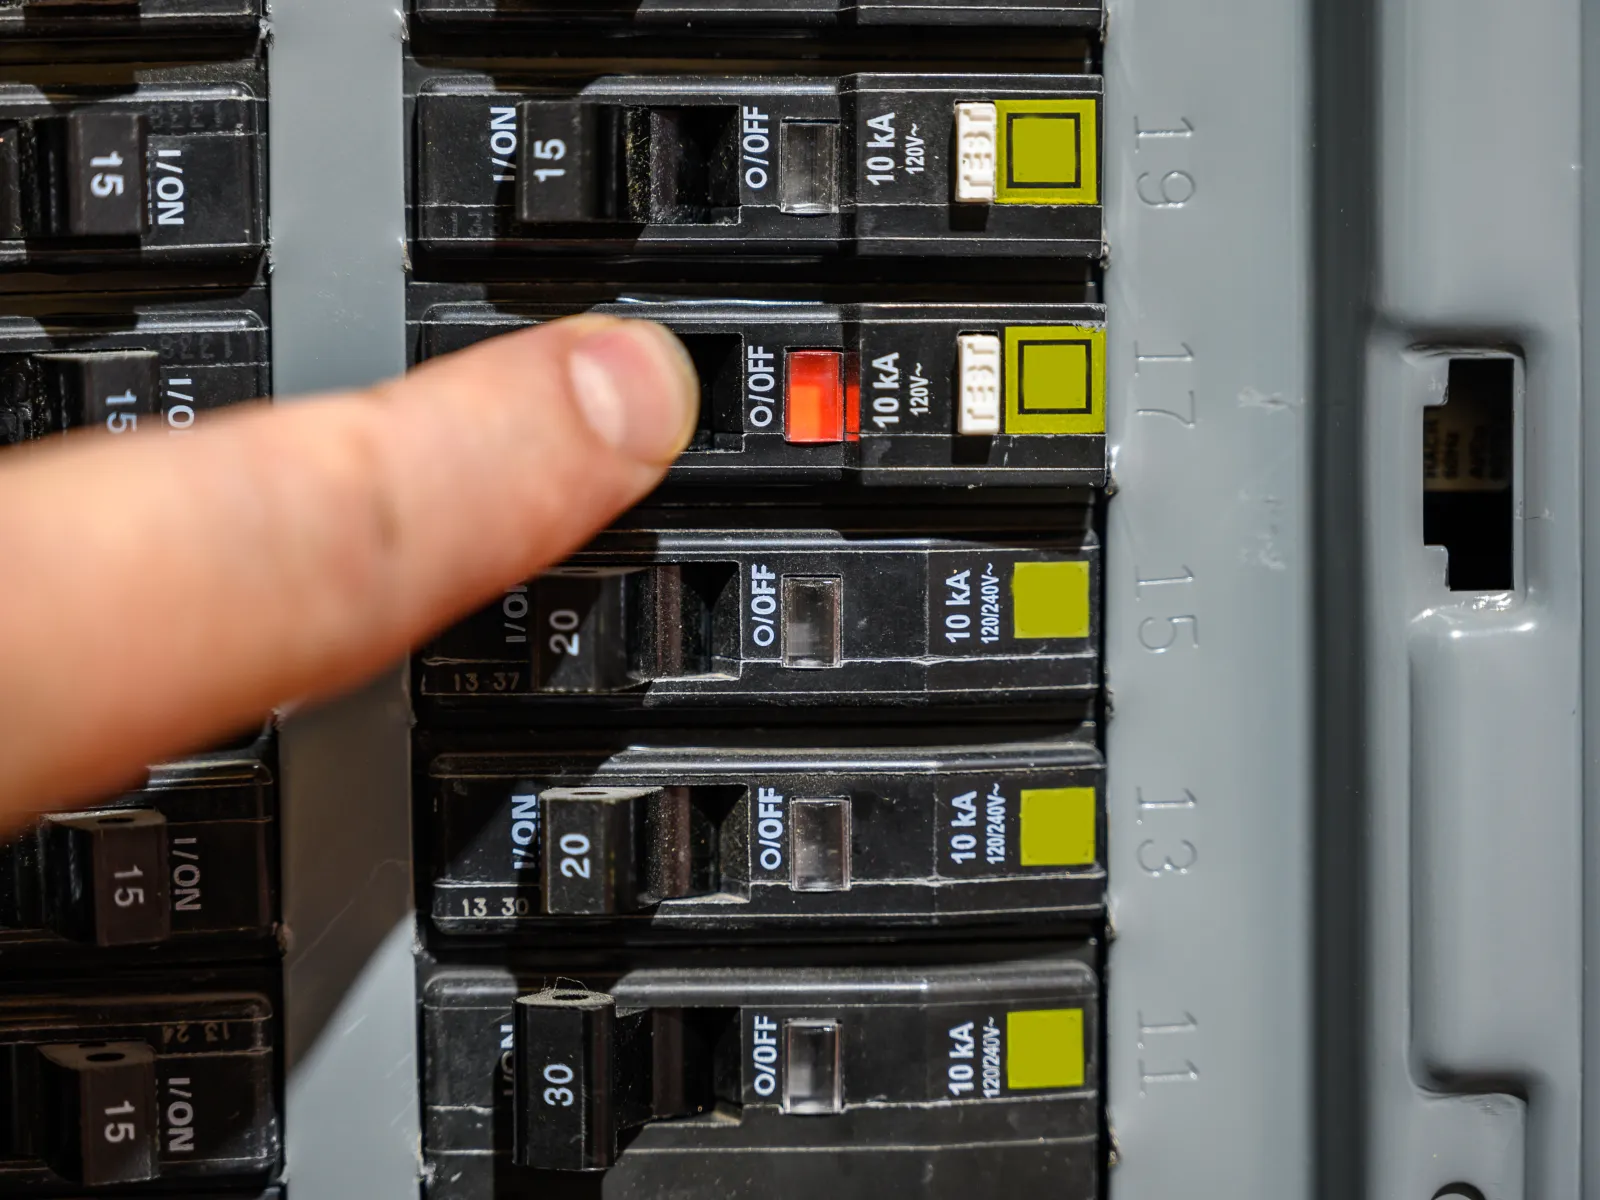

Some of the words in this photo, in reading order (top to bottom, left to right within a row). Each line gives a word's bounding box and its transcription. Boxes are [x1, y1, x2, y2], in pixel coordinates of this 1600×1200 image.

[490, 107, 517, 182] I/ON
[742, 106, 770, 189] O/OFF
[867, 112, 896, 148] kA
[962, 108, 993, 187] TEST
[90, 152, 123, 197] 15
[533, 138, 566, 183] 15
[866, 157, 895, 186] 10
[1134, 116, 1196, 208] 19
[156, 149, 185, 226] I/ON
[747, 345, 775, 428] O/OFF
[872, 352, 900, 390] kA
[966, 342, 996, 420] TEST
[1134, 341, 1196, 429] 17
[106, 389, 138, 434] 15
[167, 378, 195, 437] I/O
[872, 399, 900, 429] 10
[751, 563, 777, 647] O/OFF
[945, 569, 971, 606] kA
[1136, 564, 1199, 654] 15
[549, 608, 580, 657] 20
[945, 616, 971, 644] 10
[511, 794, 537, 871] I/ON
[757, 787, 784, 871] O/OFF
[951, 790, 978, 828] kA
[1136, 786, 1198, 877] 13
[173, 837, 202, 911] I/ON
[559, 833, 591, 880] 20
[950, 836, 977, 865] 10
[113, 864, 144, 908] 15
[461, 897, 487, 918] 13
[501, 897, 529, 917] 30
[752, 1015, 778, 1097] O/OFF
[949, 1021, 975, 1060] kA
[1136, 1010, 1199, 1099] 11
[543, 1063, 574, 1107] 30
[948, 1064, 974, 1096] 10
[104, 1100, 136, 1144] 15
[167, 1077, 195, 1153] I/ON
